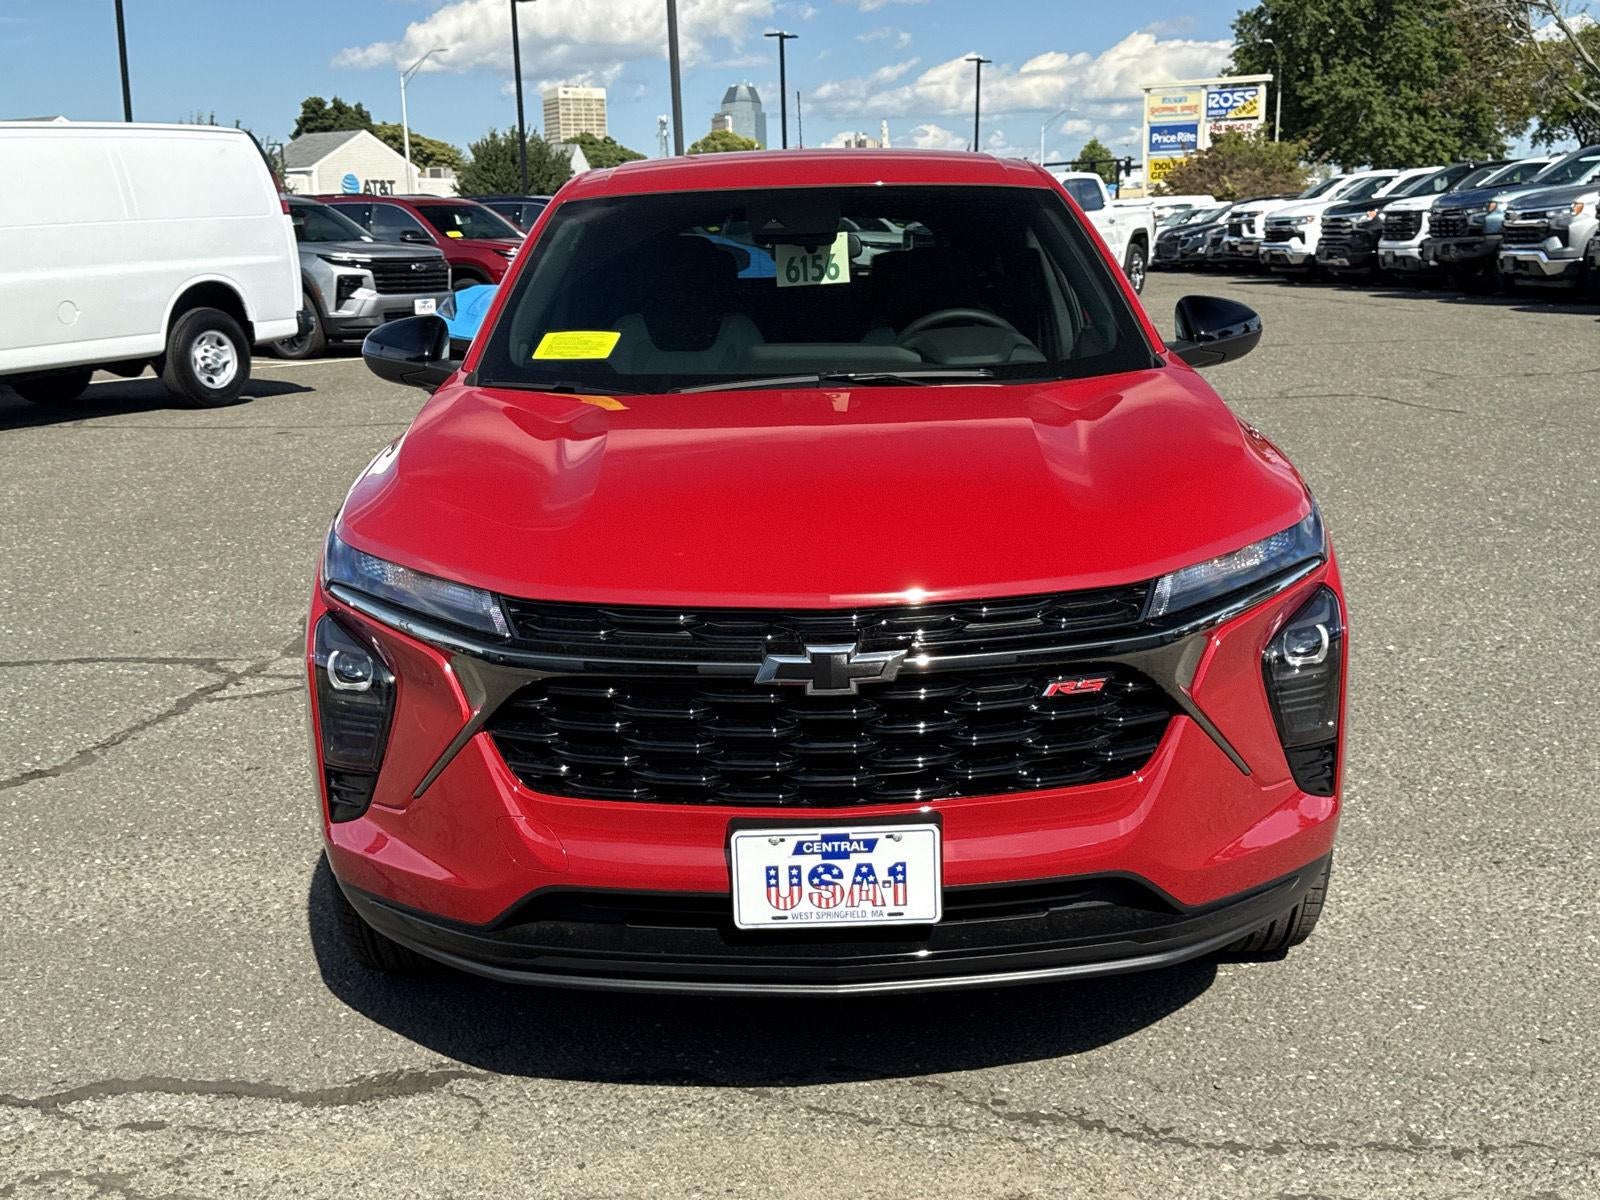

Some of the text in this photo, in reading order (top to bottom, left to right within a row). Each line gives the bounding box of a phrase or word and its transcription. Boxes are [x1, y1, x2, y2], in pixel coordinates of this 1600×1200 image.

[1208, 91, 1257, 108] ROSS
[363, 179, 396, 196] AT&T
[785, 253, 840, 283] 6156
[1042, 677, 1106, 697] RS
[802, 840, 869, 854] CENTRAL
[765, 861, 908, 911] USA-1
[791, 911, 814, 920] WEST
[871, 909, 885, 918] MA
